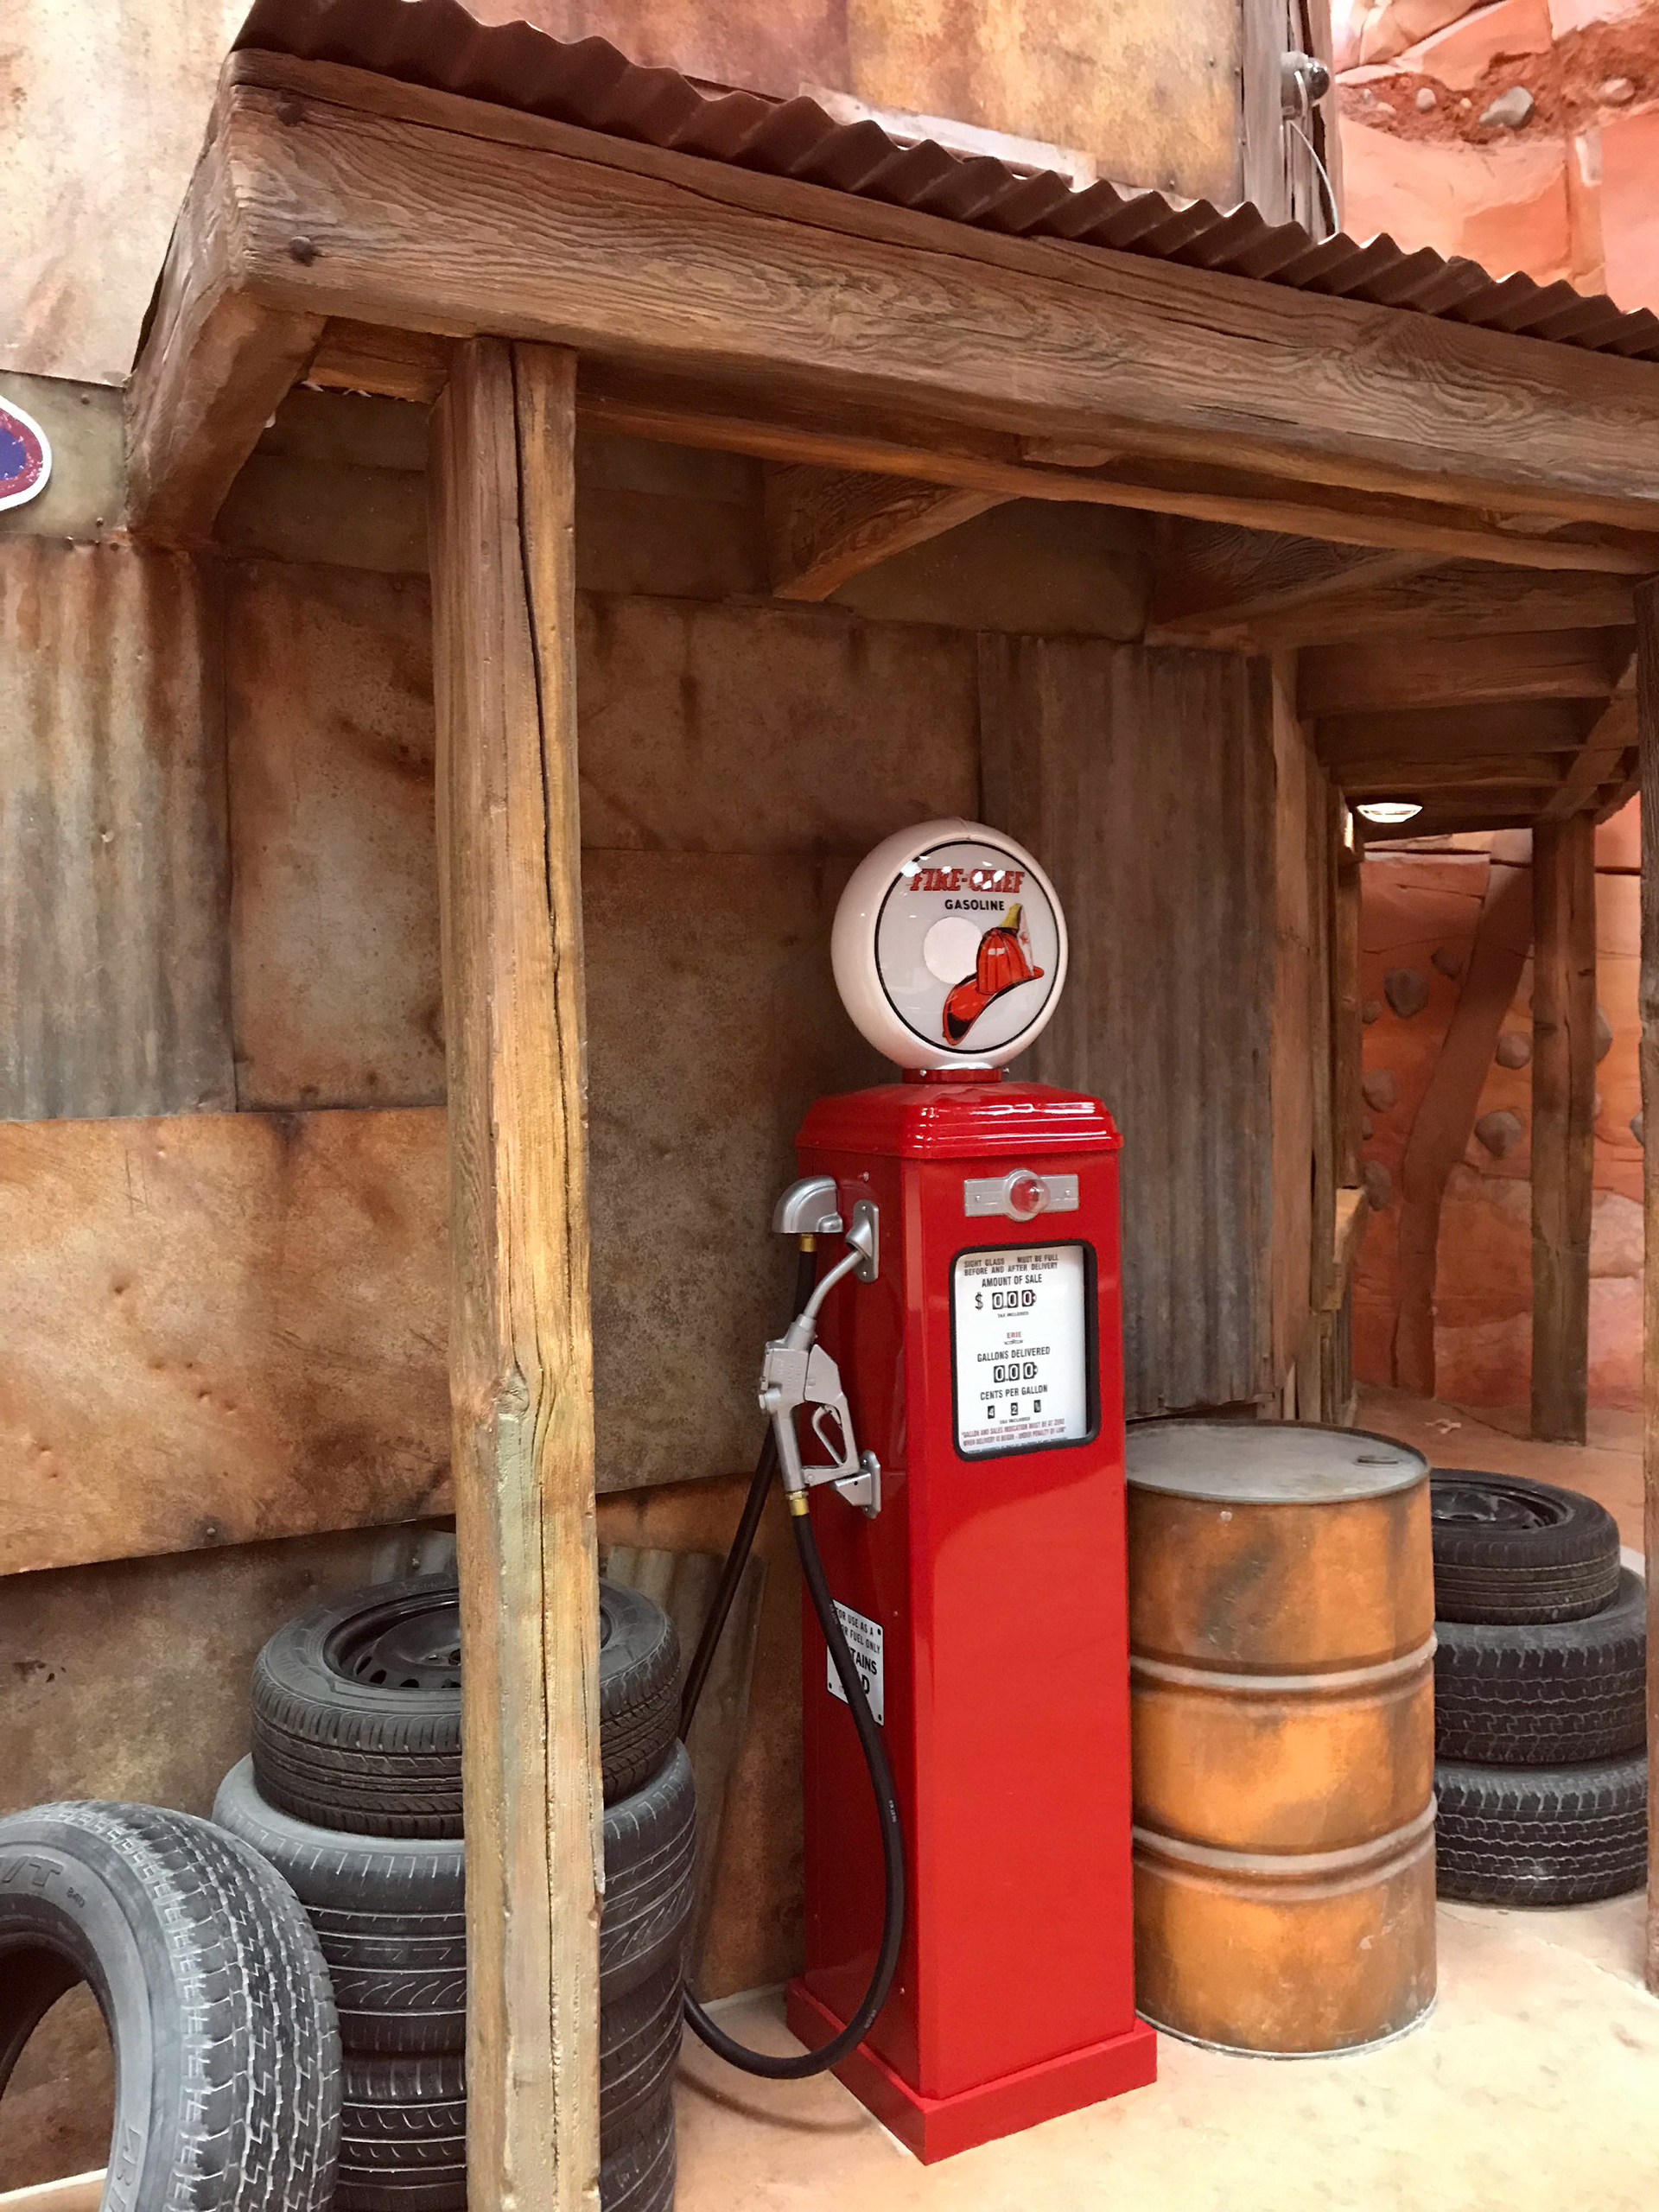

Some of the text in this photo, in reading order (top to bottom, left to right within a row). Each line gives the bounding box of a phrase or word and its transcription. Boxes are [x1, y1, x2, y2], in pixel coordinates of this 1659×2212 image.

[944, 899, 1005, 911] GASOLINE
[964, 1268, 988, 1276] BEFORE
[1032, 1262, 1058, 1270] DELIVERY
[982, 1274, 1042, 1287] AMOUNT OF SALE
[975, 1292, 983, 1311] $
[977, 1346, 1051, 1362] GALLONS DELIVERED
[980, 1384, 1047, 1401] CENTS PER GALLON
[836, 1608, 846, 1621] OR
[848, 1614, 858, 1628] USE
[860, 1622, 868, 1633] AS
[870, 1627, 874, 1637] A
[850, 1630, 864, 1645] FUEL
[866, 1639, 880, 1655] ONLY
[849, 1647, 877, 1675] TAINS
